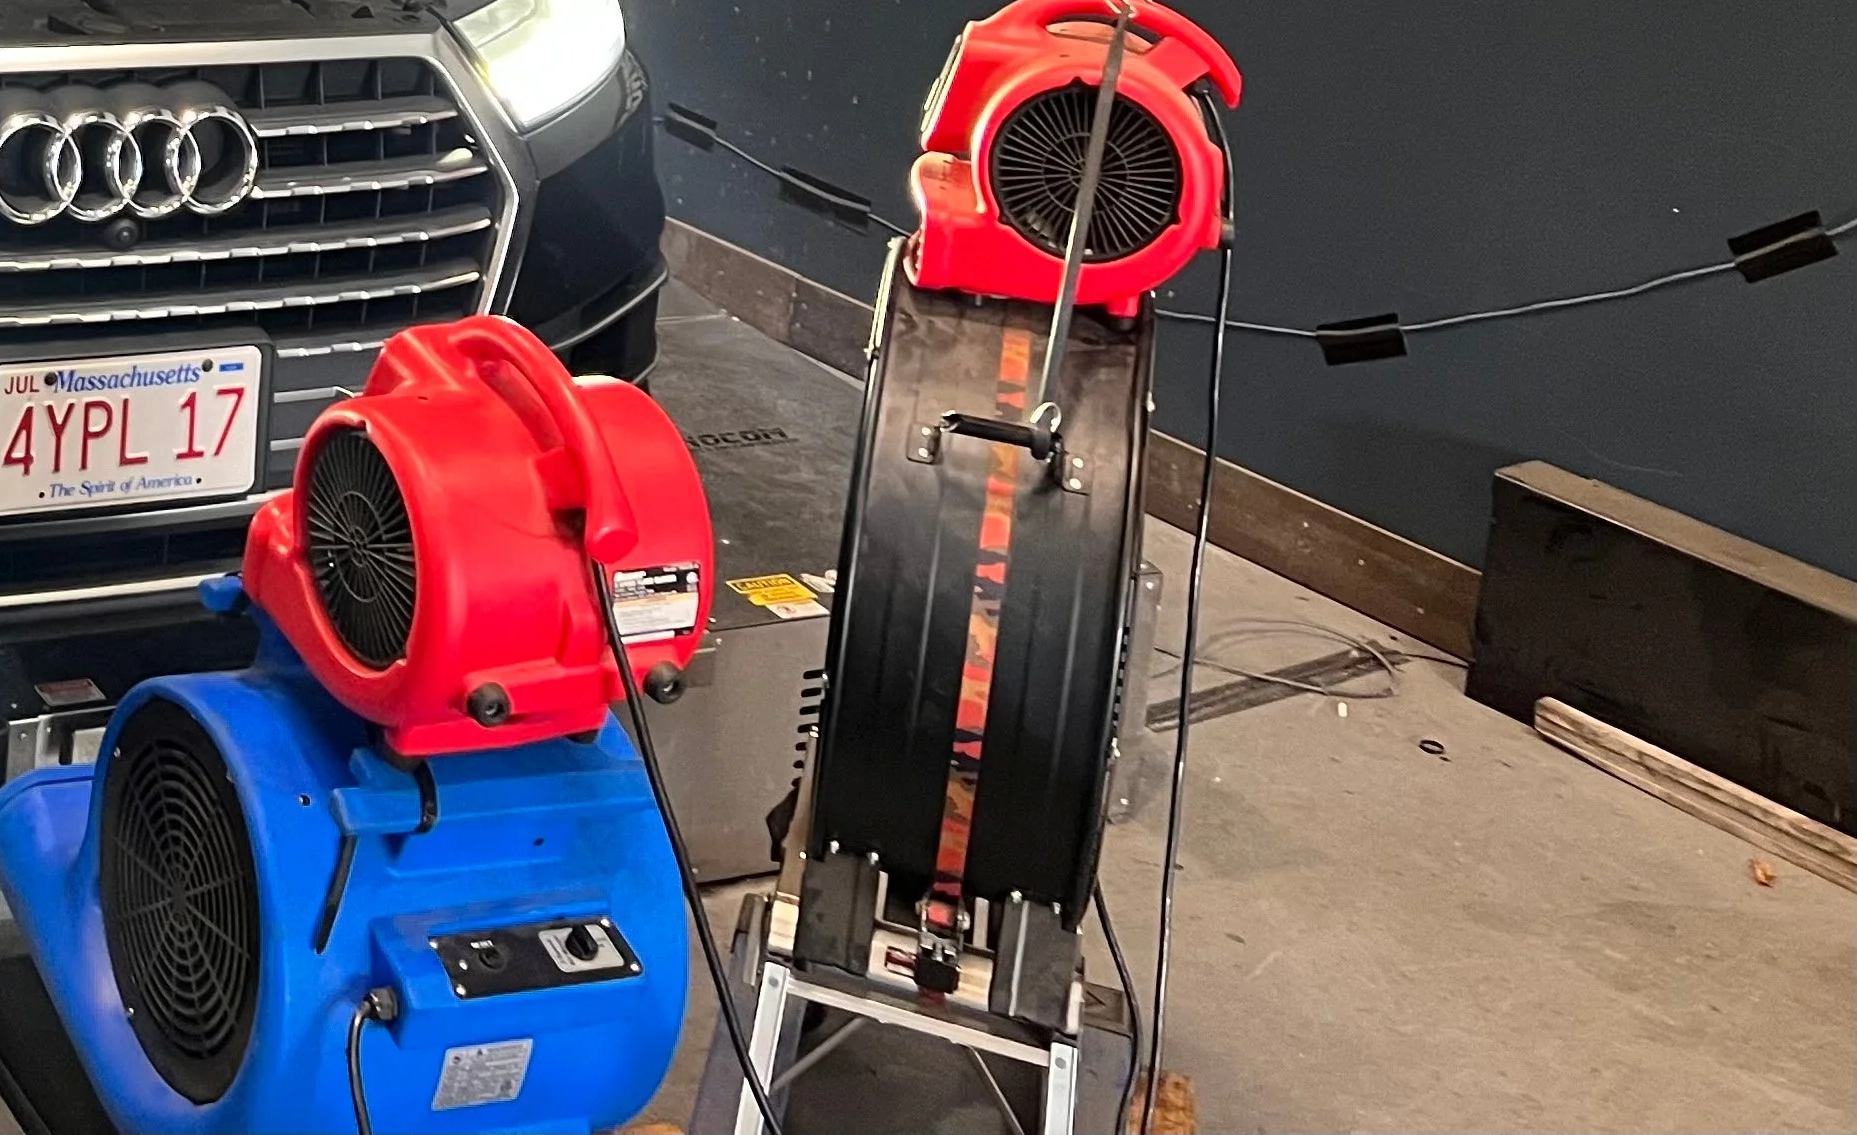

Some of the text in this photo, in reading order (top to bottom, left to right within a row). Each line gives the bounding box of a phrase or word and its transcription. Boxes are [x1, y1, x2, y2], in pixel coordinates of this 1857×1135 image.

[4, 364, 202, 395] JUL Massachusetts
[1, 385, 246, 478] 4YPL 17
[49, 474, 193, 498] The Spirit of America
